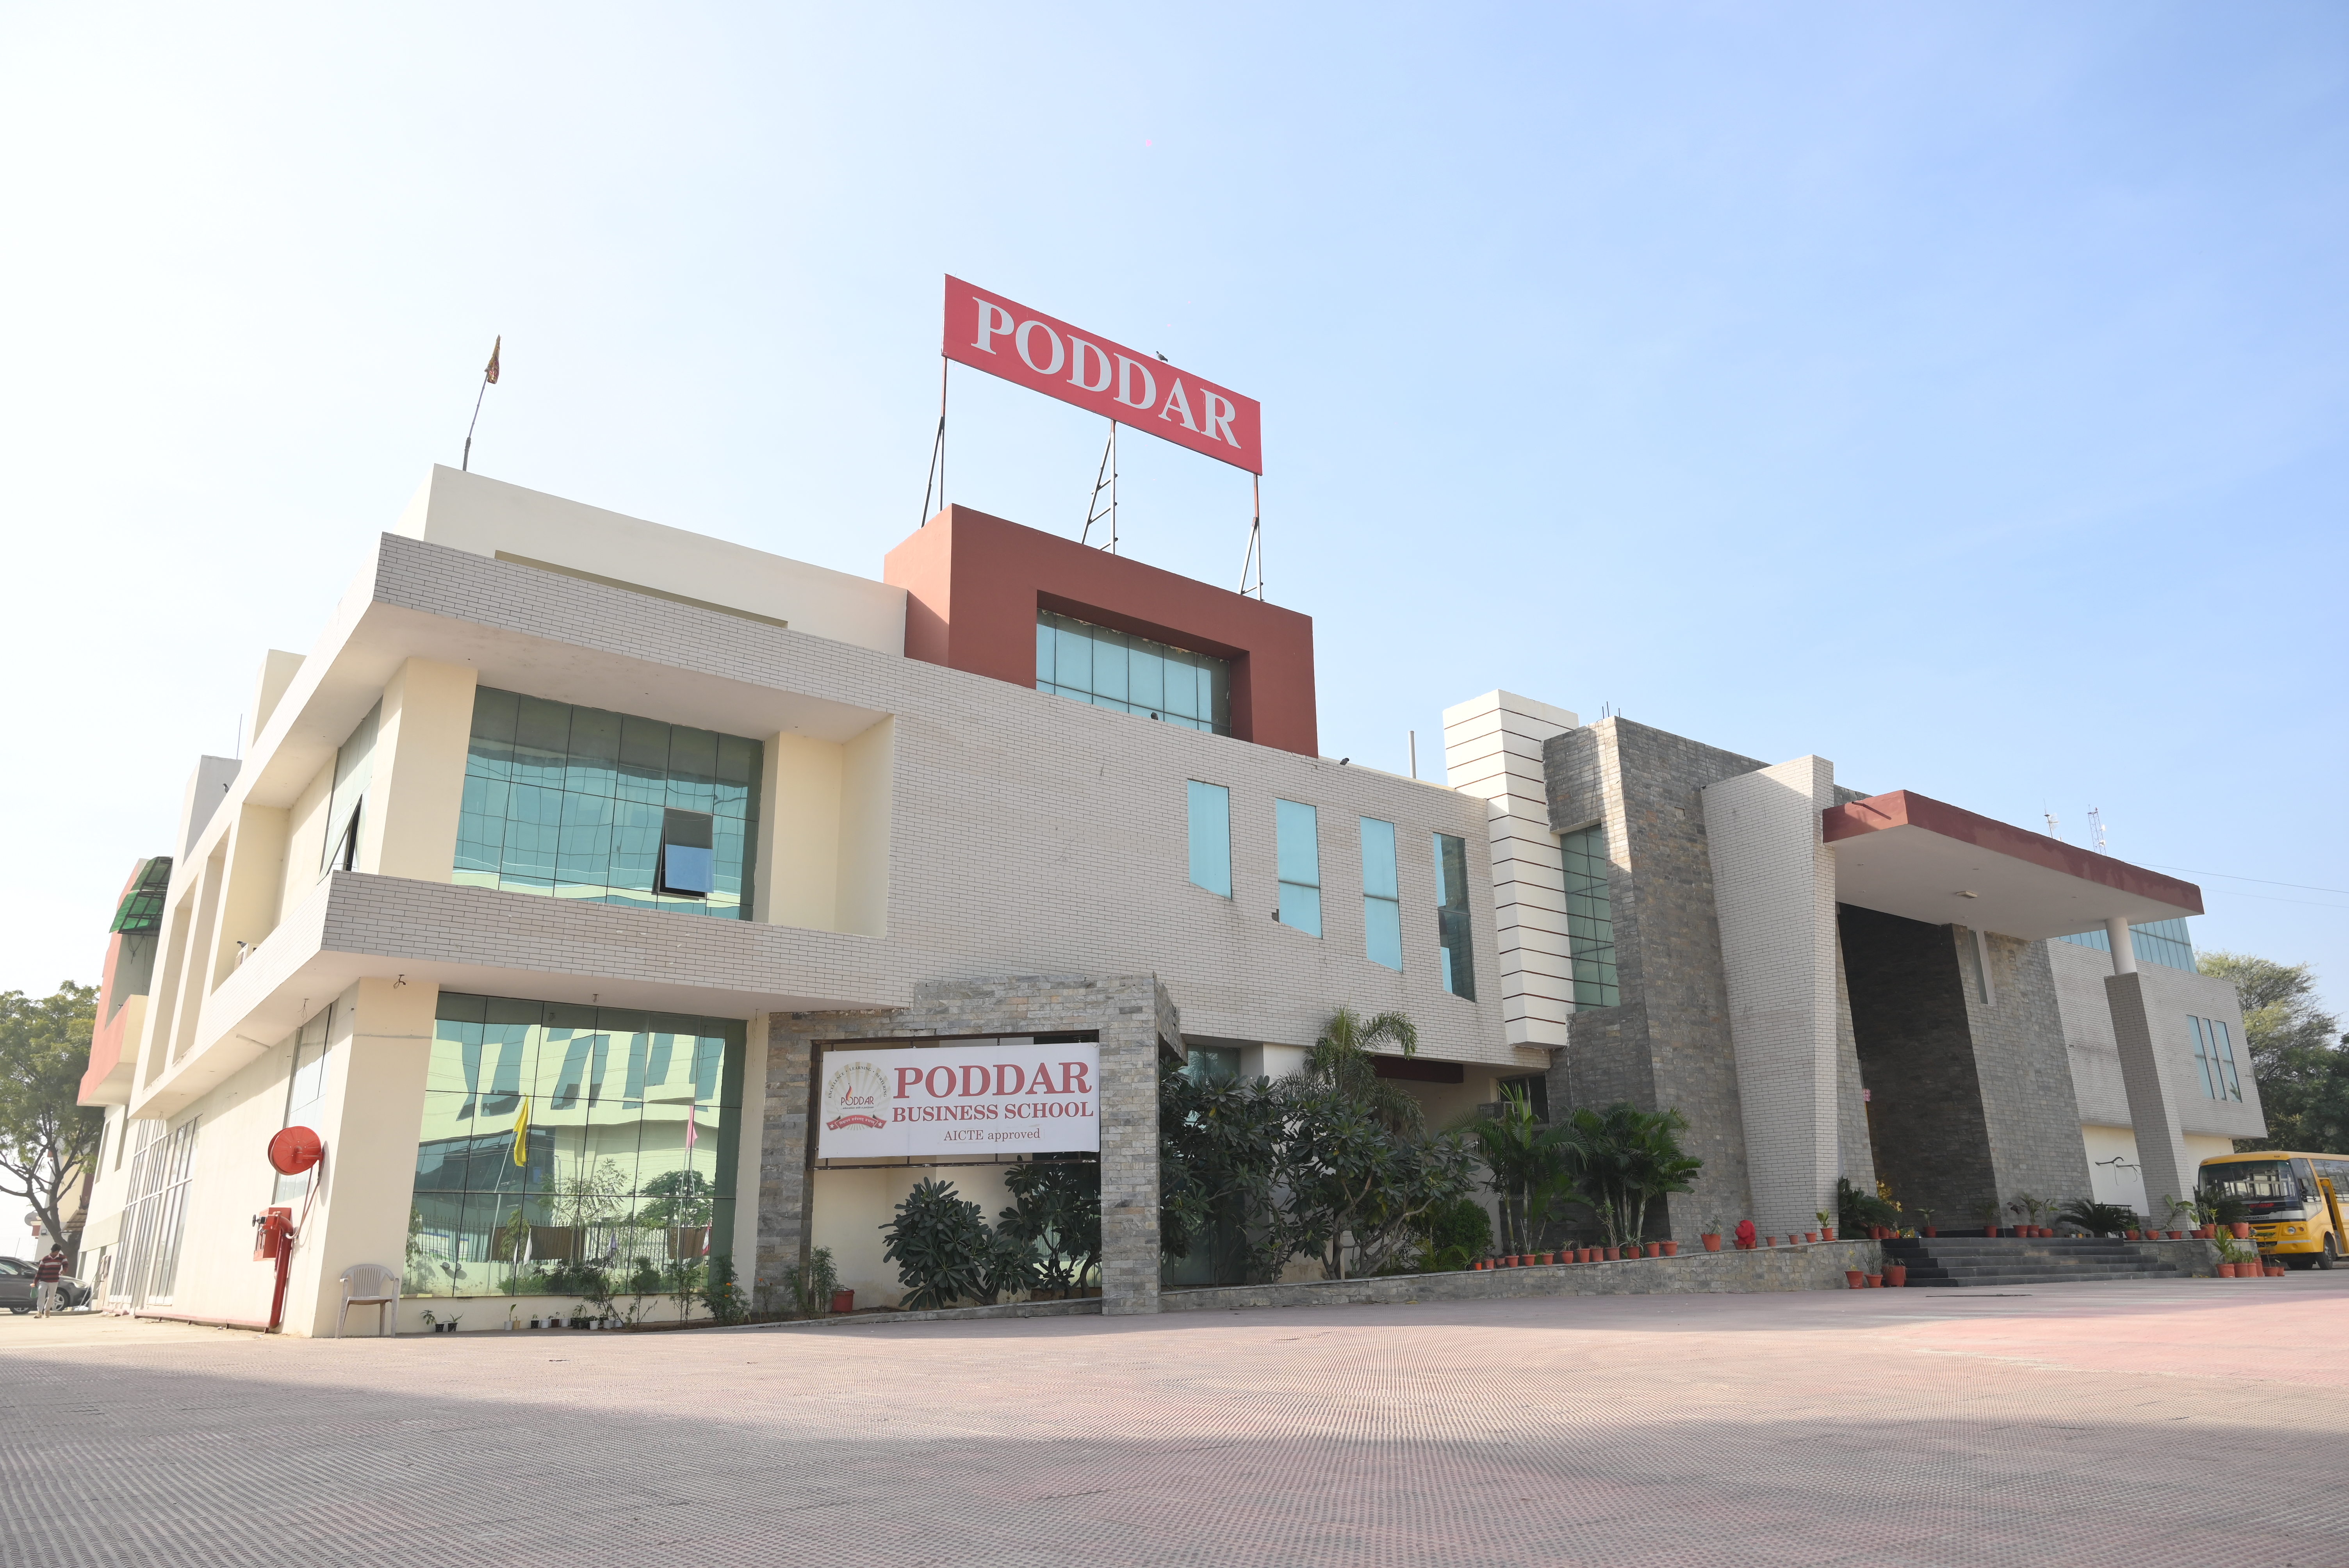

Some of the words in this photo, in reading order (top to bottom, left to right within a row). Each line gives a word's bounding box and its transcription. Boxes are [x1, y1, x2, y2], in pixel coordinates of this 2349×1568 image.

[971, 296, 1242, 449] PODDAR
[828, 1072, 845, 1098] EXCELLENCE
[875, 1073, 887, 1097] NURTURING
[893, 1062, 1092, 1099] PODDAR
[841, 1096, 874, 1106] PODDAR
[892, 1105, 998, 1122] BUSINESS
[1004, 1102, 1094, 1118] SCHOOL
[943, 1130, 984, 1141] AICTE
[987, 1128, 1041, 1142] approved
